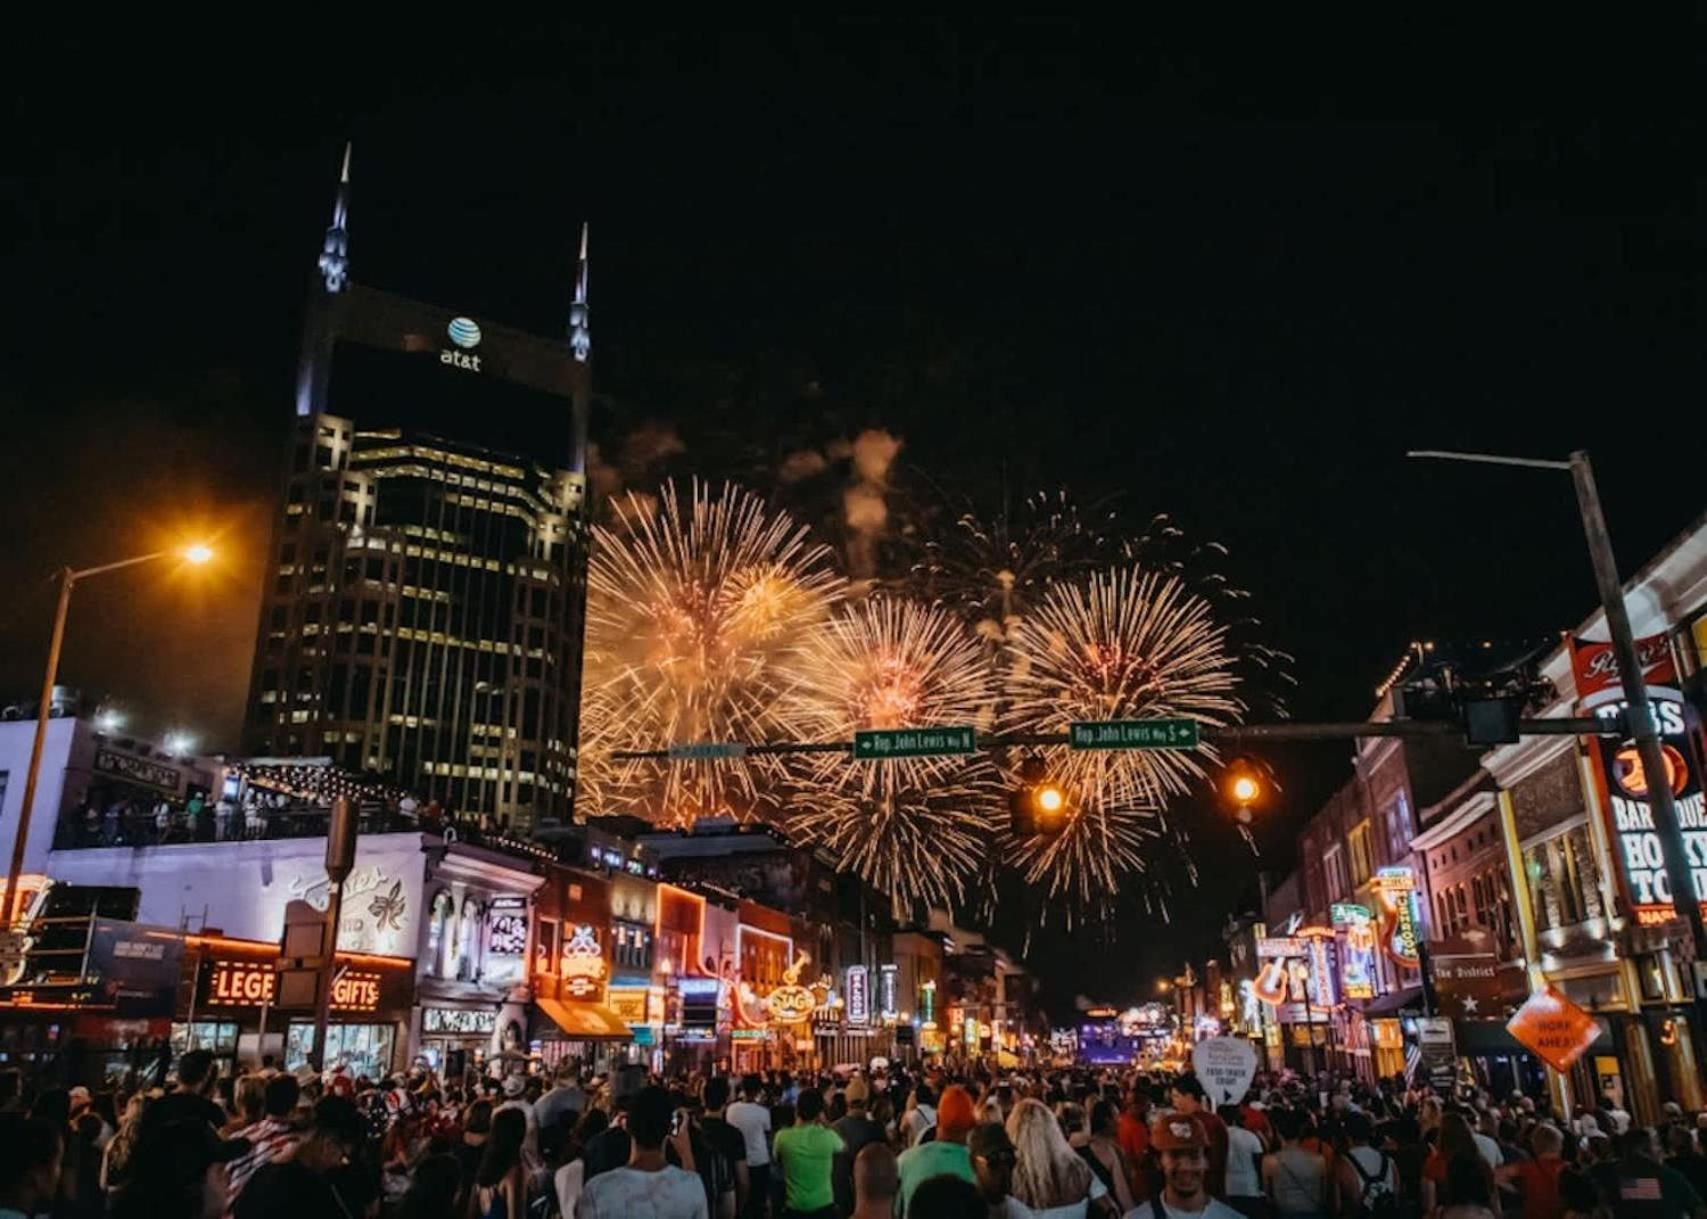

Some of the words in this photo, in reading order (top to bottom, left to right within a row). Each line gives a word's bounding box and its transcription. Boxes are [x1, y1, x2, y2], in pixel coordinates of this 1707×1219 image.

[440, 349, 481, 372] at&t
[894, 733, 917, 750] John
[918, 732, 945, 749] Lewis
[1097, 724, 1120, 742] John
[1121, 723, 1150, 742] Lewis
[1168, 723, 1177, 742] S
[217, 970, 275, 999] LEGE
[333, 979, 377, 1005] GIFTS
